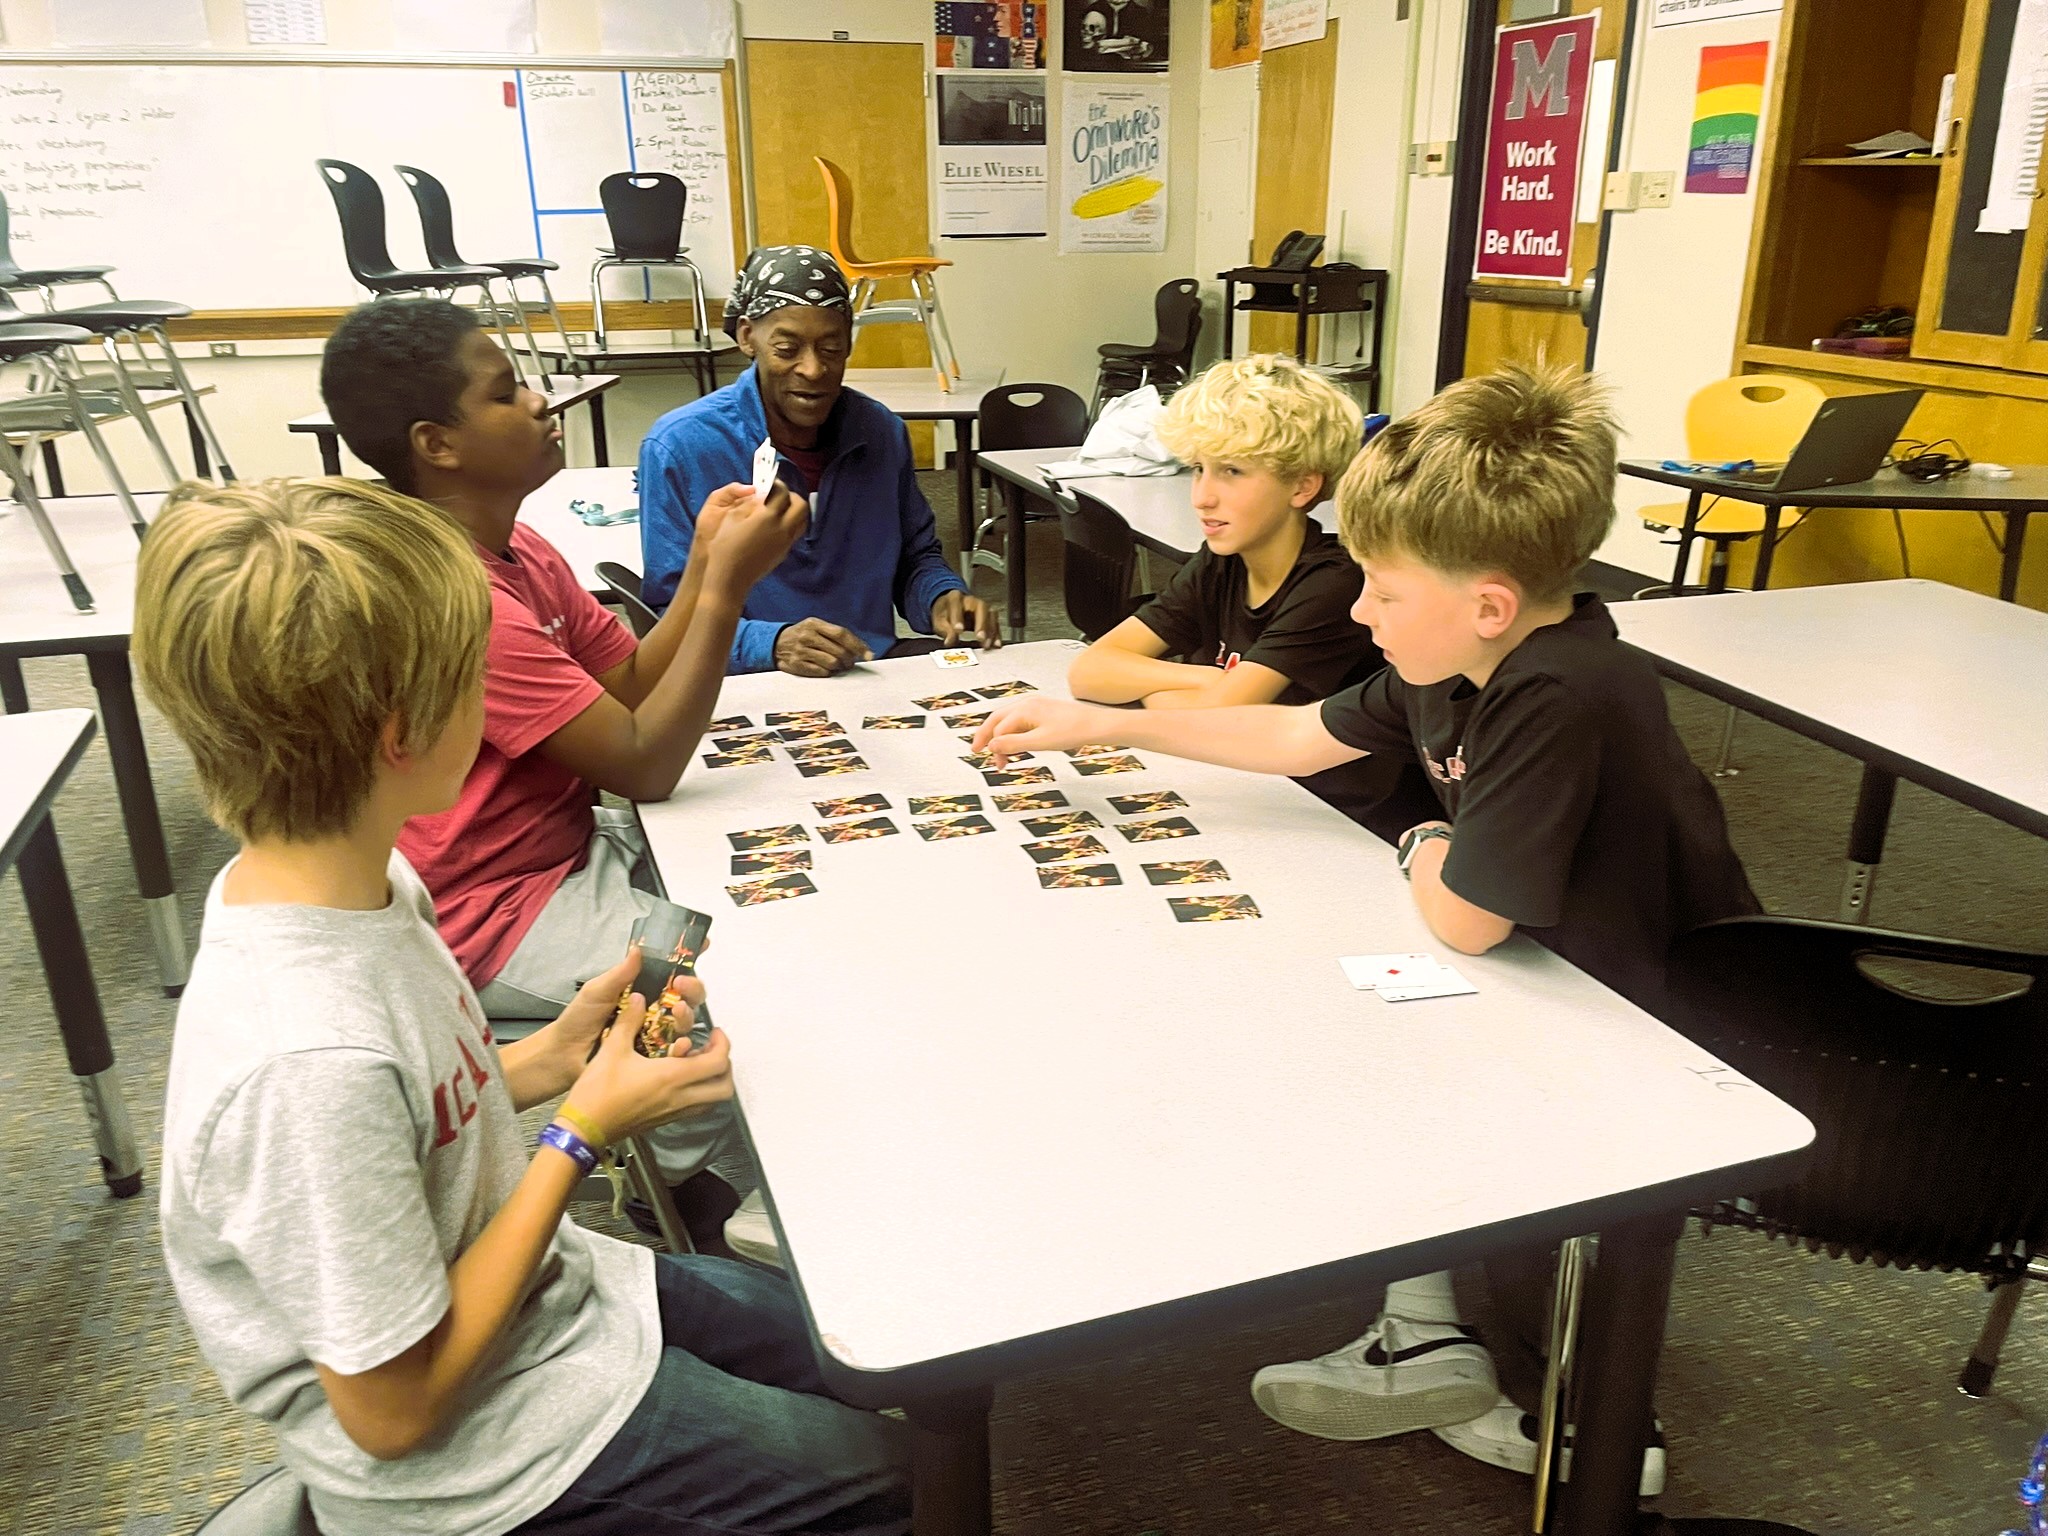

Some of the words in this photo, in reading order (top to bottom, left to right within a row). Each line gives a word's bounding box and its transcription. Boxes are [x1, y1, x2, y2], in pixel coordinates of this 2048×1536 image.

[634, 72, 698, 87] AGENDA
[1504, 32, 1577, 120] M
[1506, 139, 1558, 168] Work
[984, 162, 1044, 178] WIESEL
[1501, 174, 1554, 201] Hard.
[1483, 229, 1510, 255] Be
[1512, 228, 1563, 257] Kind.
